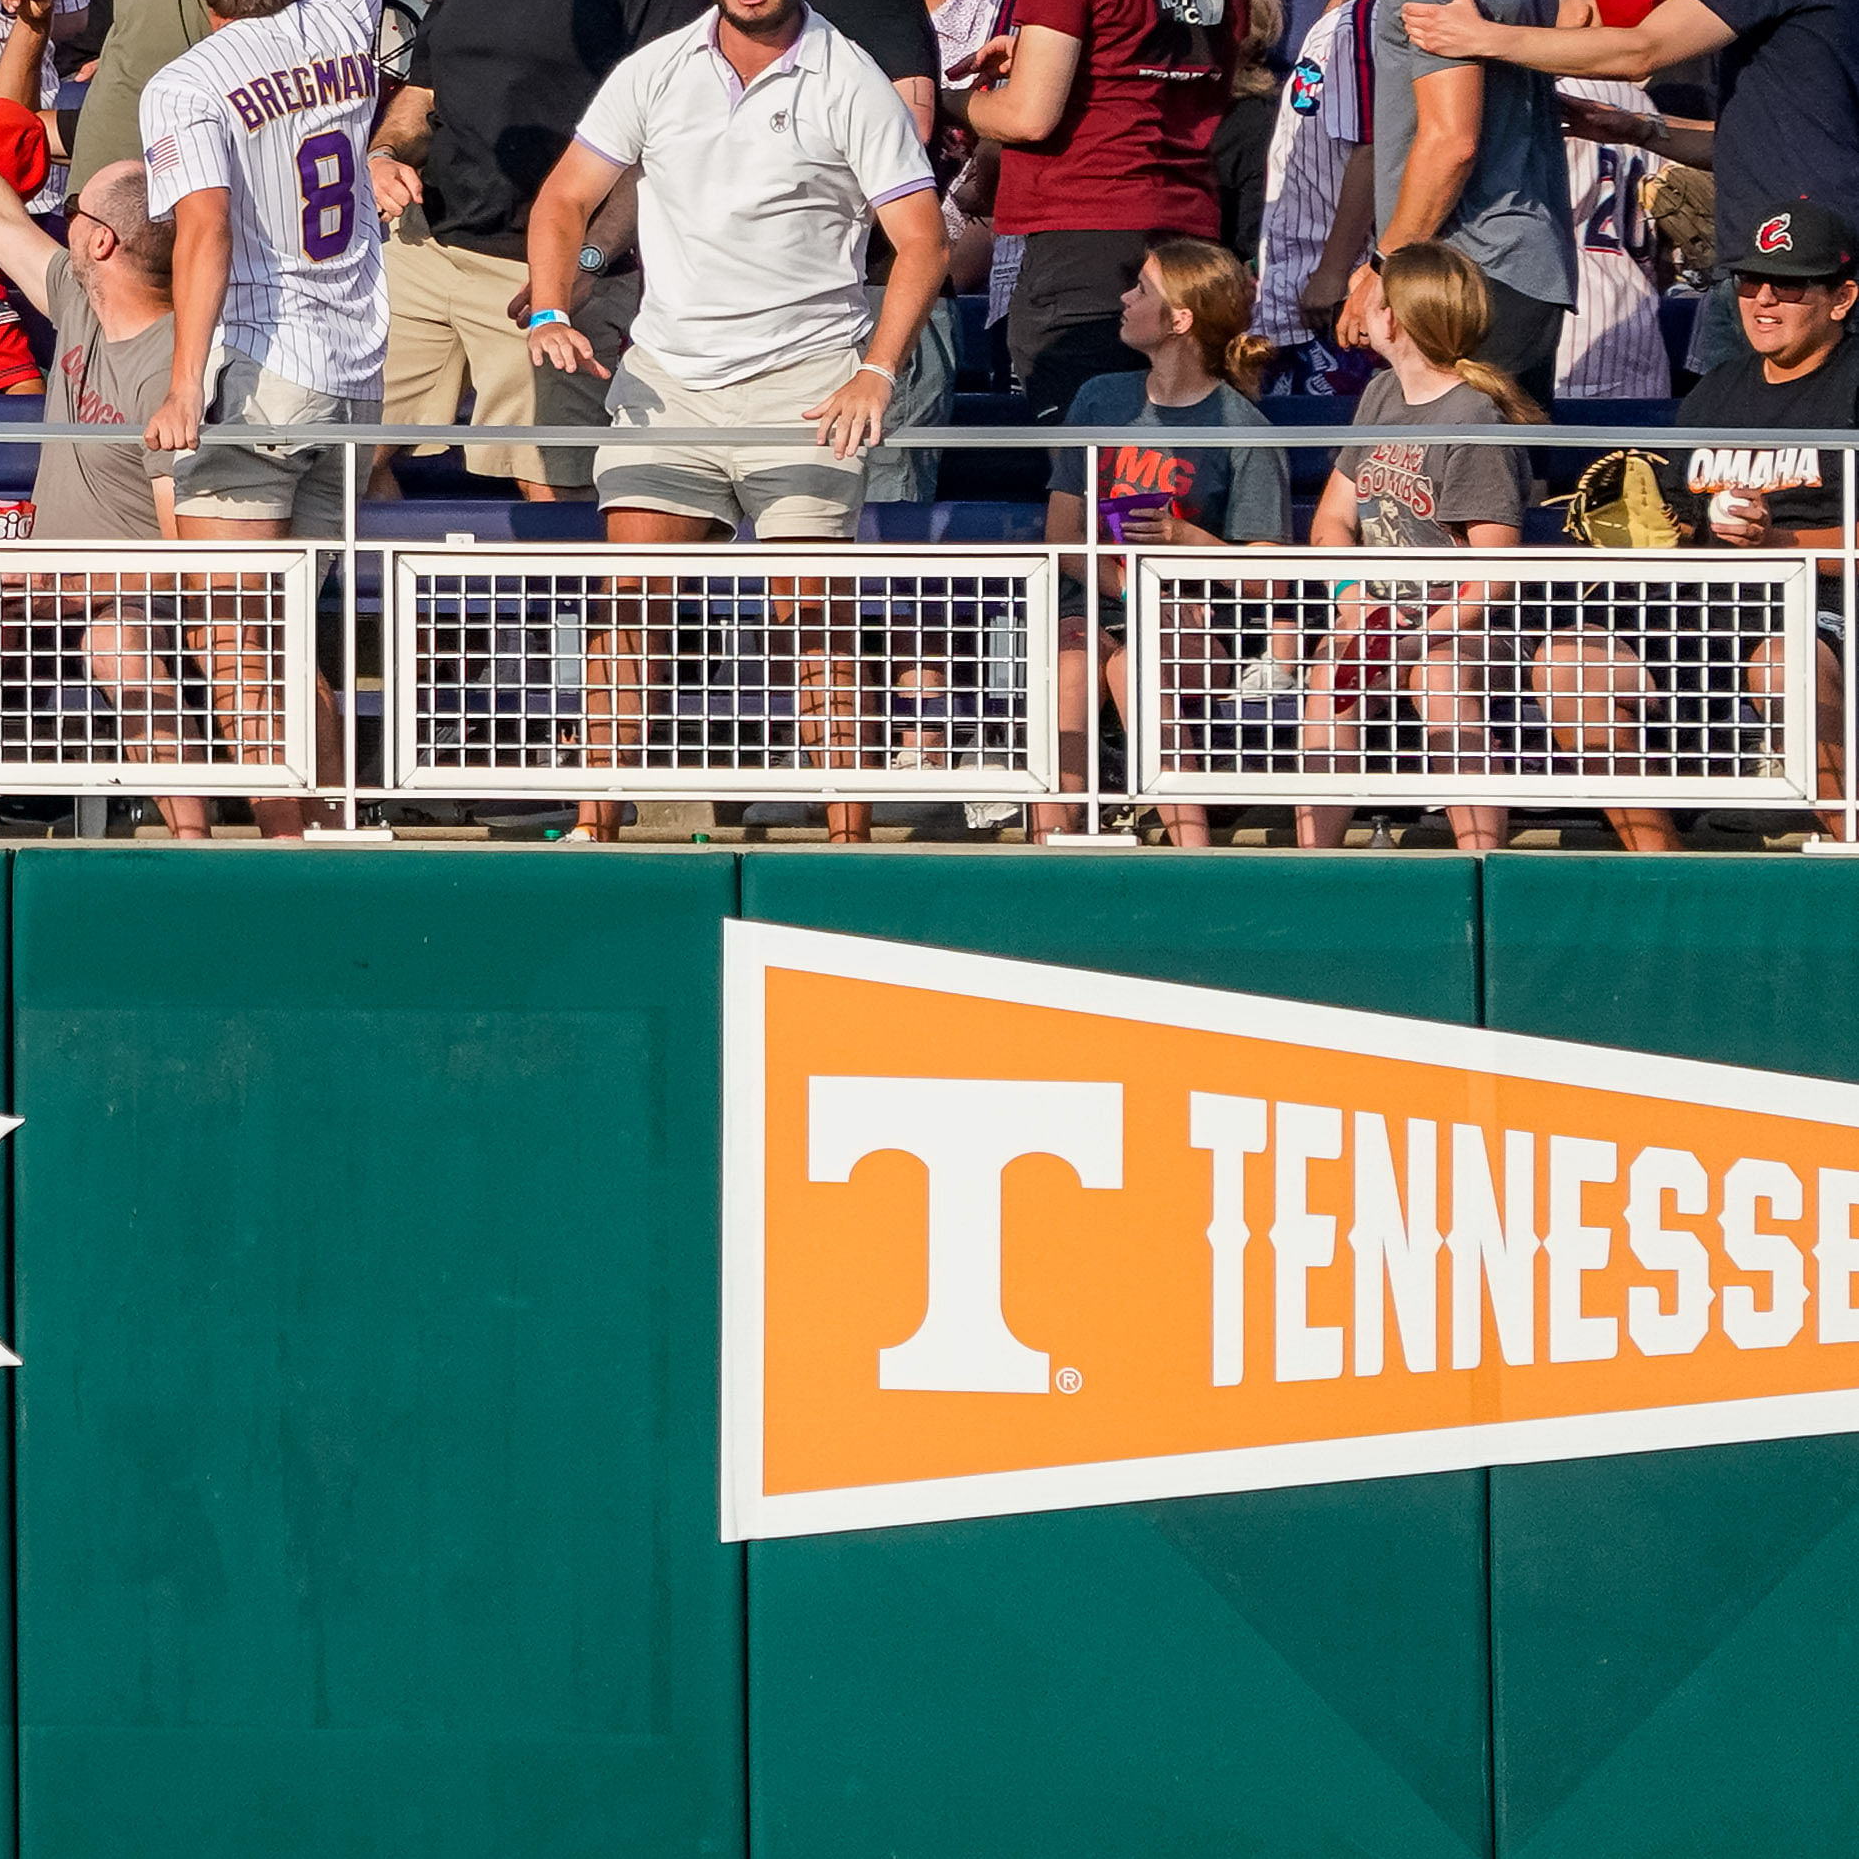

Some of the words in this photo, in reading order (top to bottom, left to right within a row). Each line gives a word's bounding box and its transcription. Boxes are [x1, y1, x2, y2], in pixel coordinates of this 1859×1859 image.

[226, 52, 378, 134] BREGMAN
[296, 128, 356, 263] 8
[1355, 464, 1436, 521] COMBS
[1688, 447, 1823, 494] OMAHA
[809, 1076, 1122, 1393] T
